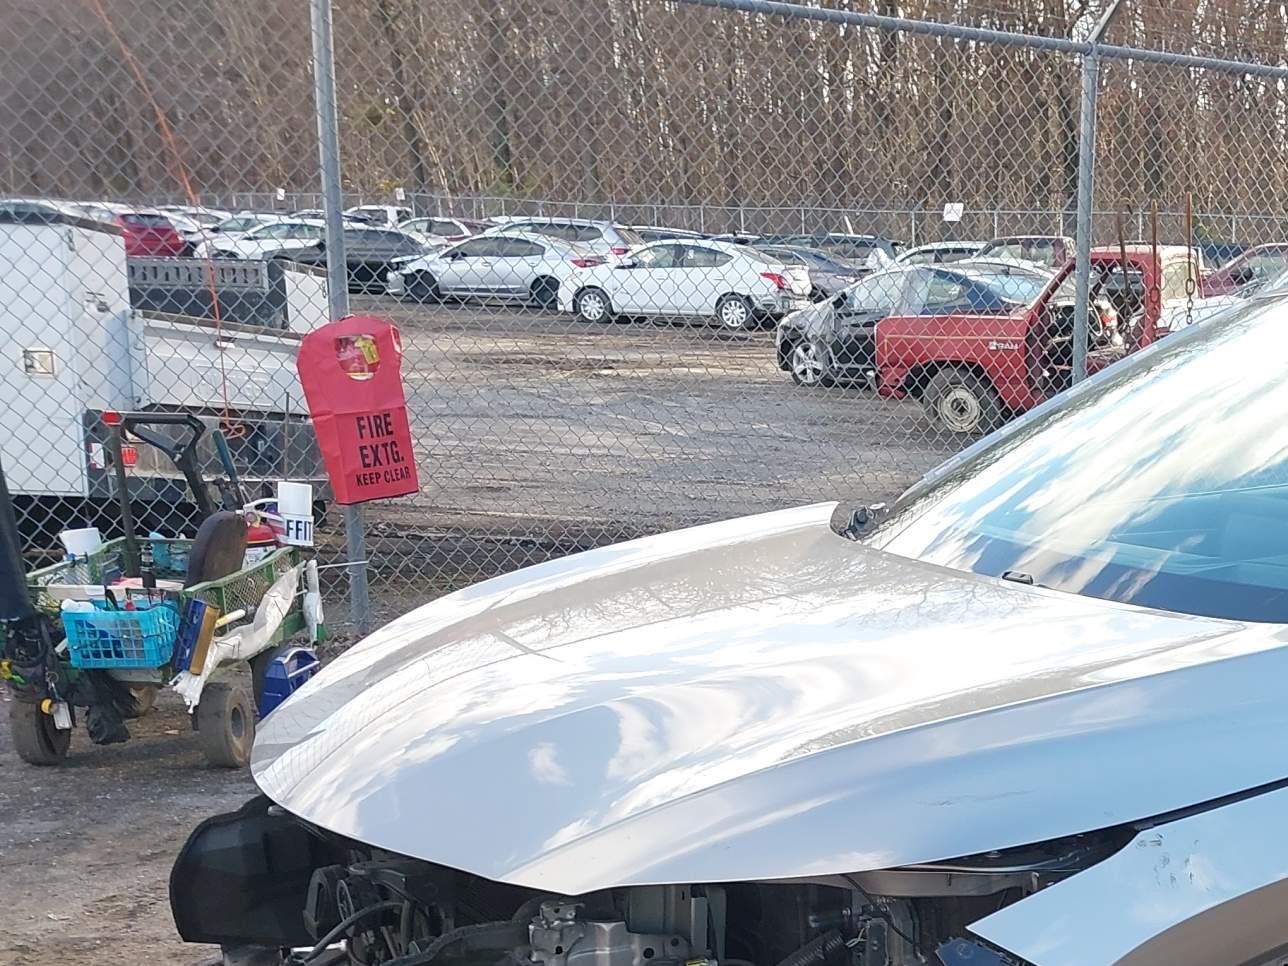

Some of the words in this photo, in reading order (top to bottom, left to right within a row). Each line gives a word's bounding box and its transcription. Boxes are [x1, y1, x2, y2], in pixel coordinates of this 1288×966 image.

[356, 413, 394, 440] FIRE
[359, 440, 405, 469] EXTG.
[356, 471, 382, 487] KEEP
[384, 466, 411, 484] CLEAR
